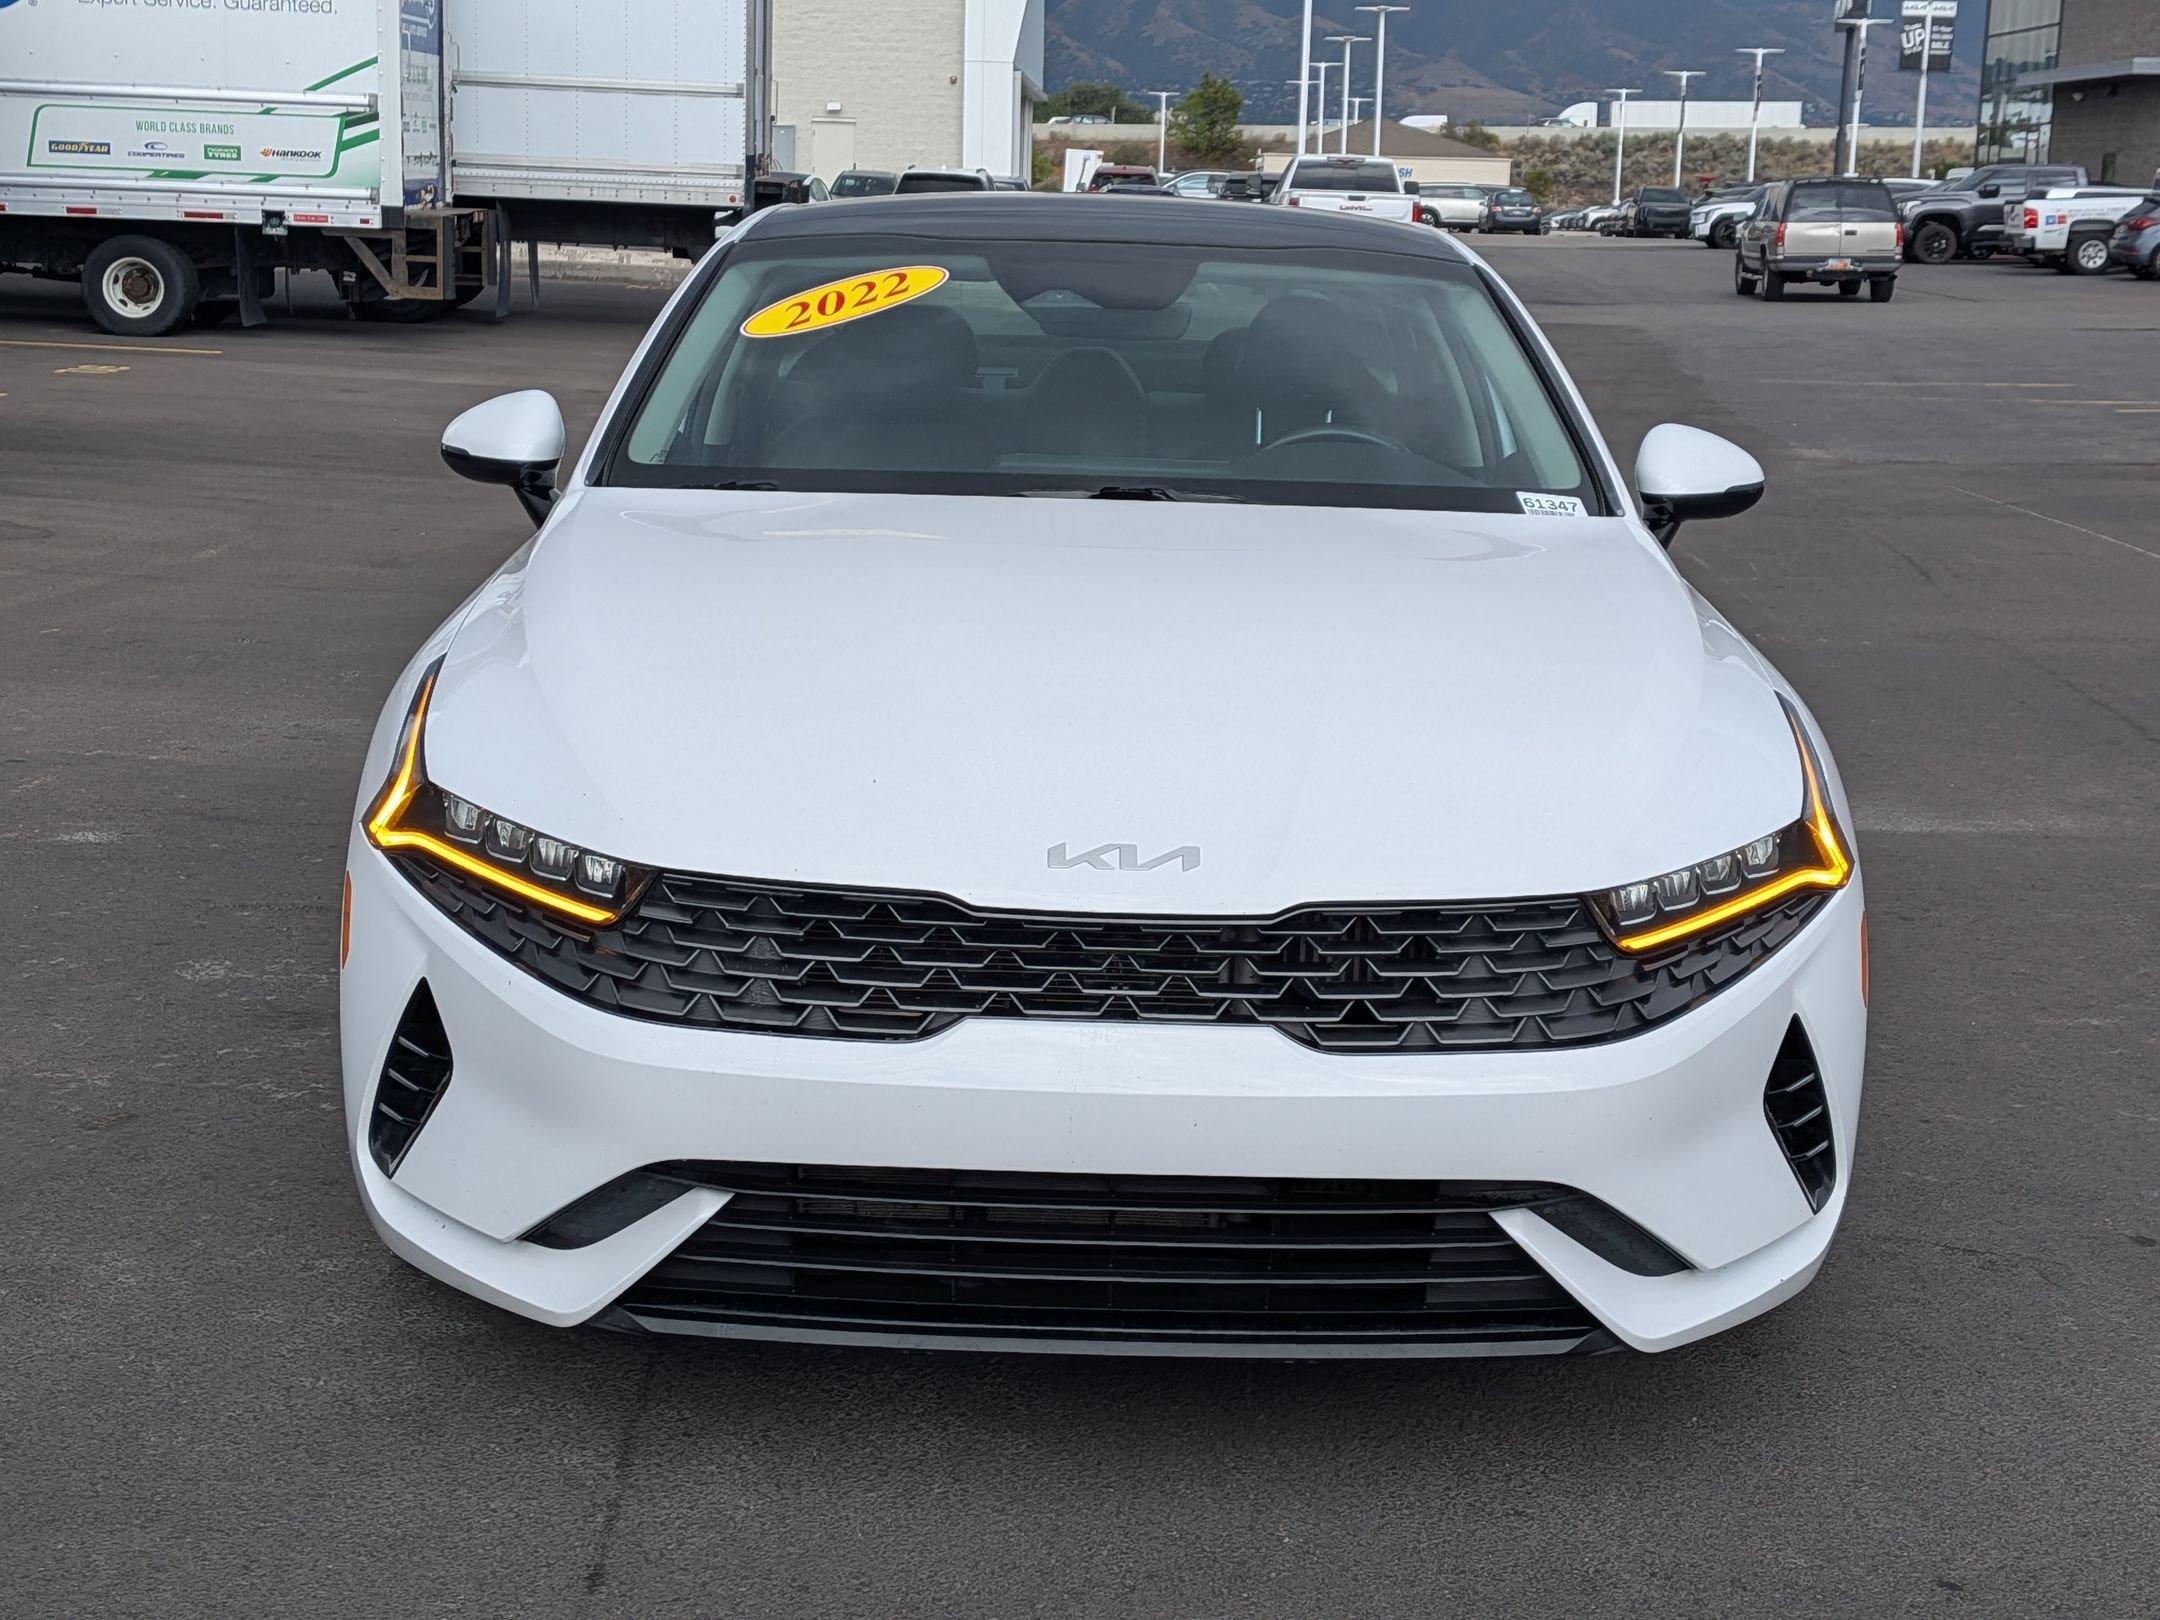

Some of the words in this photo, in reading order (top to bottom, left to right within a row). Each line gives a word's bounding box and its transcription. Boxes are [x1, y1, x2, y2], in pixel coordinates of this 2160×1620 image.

[1901, 28, 1925, 48] UP
[135, 120, 167, 132] WORLD
[169, 121, 197, 134] CLASS
[199, 122, 235, 135] BRANDS
[51, 141, 109, 153] GOODYEAR
[784, 272, 911, 330] 2022
[1522, 497, 1578, 513] 61347
[1047, 841, 1201, 873] KIA
